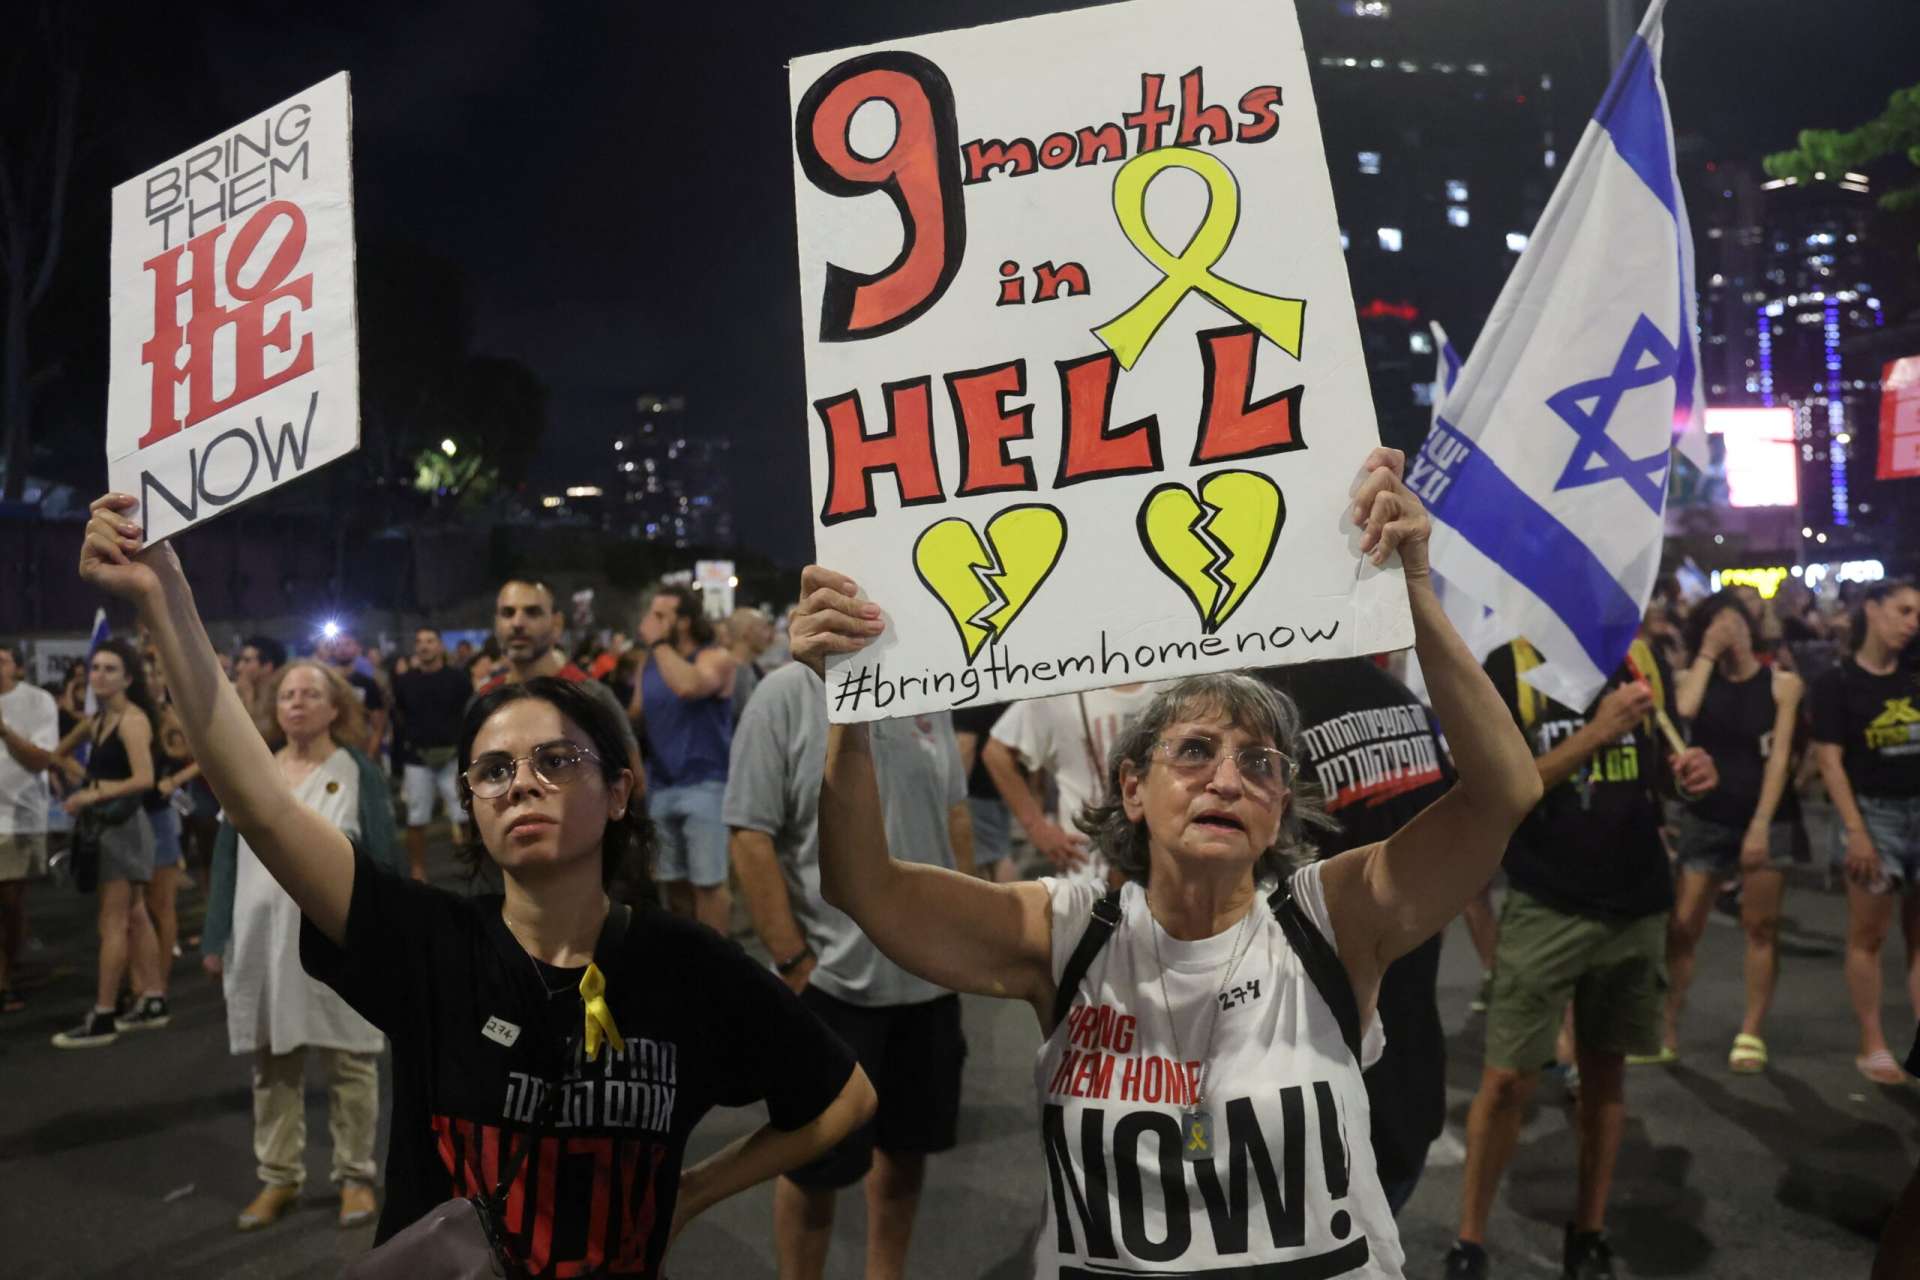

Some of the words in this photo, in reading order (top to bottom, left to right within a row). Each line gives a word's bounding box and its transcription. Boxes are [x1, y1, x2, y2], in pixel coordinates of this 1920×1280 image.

[145, 103, 311, 218] BRING
[149, 141, 309, 250] THEM
[796, 50, 967, 342] 9
[962, 66, 1283, 185] months
[143, 200, 308, 342] HO
[996, 260, 1091, 306] in
[138, 272, 314, 449] ME
[140, 390, 319, 543] NOW
[813, 322, 1308, 526] HELL
[835, 621, 1340, 712] #bringthemhomenow
[486, 1020, 513, 1041] 274
[1067, 1004, 1137, 1054] BRNG
[1218, 979, 1261, 1012] 274
[602, 1080, 677, 1134] אותם
[1119, 1055, 1201, 1106] HOME
[1043, 1080, 1351, 1263] NOW!
